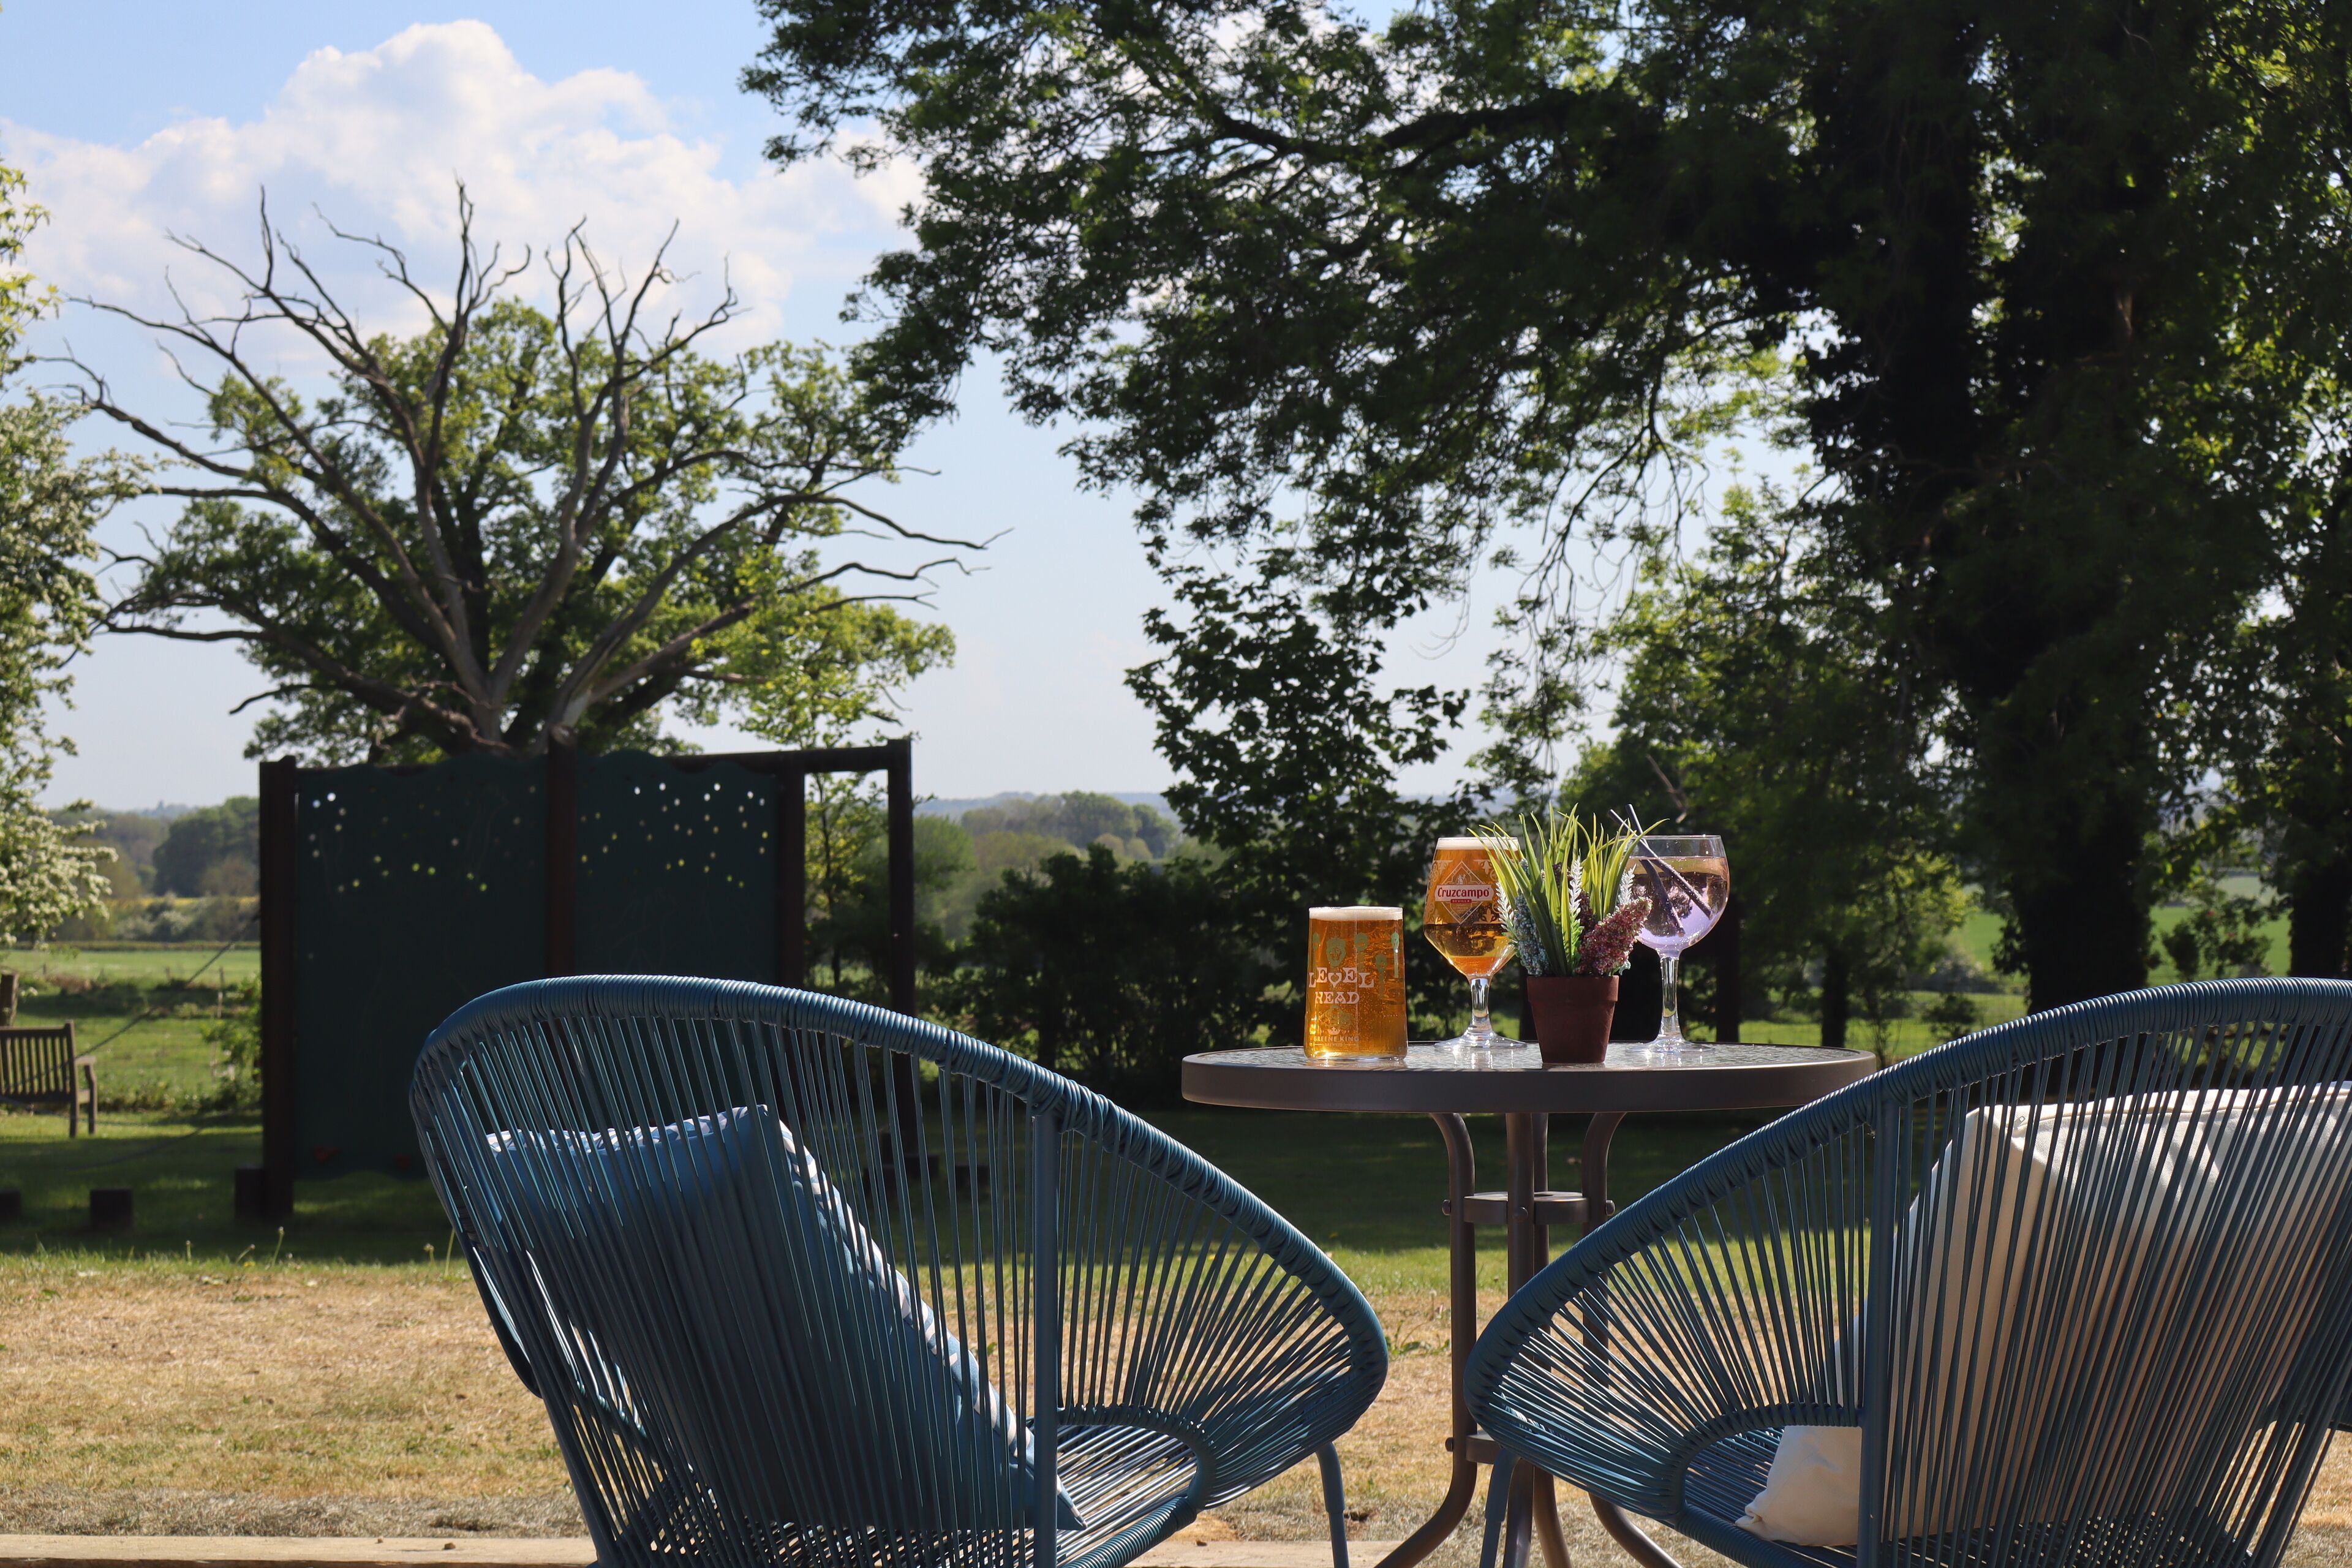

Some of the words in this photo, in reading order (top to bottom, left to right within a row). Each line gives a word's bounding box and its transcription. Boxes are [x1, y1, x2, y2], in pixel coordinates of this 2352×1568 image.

[1438, 887, 1489, 899] Cruzcampo
[1308, 967, 1374, 988] LEVEL
[1314, 992, 1360, 1004] HEAD
